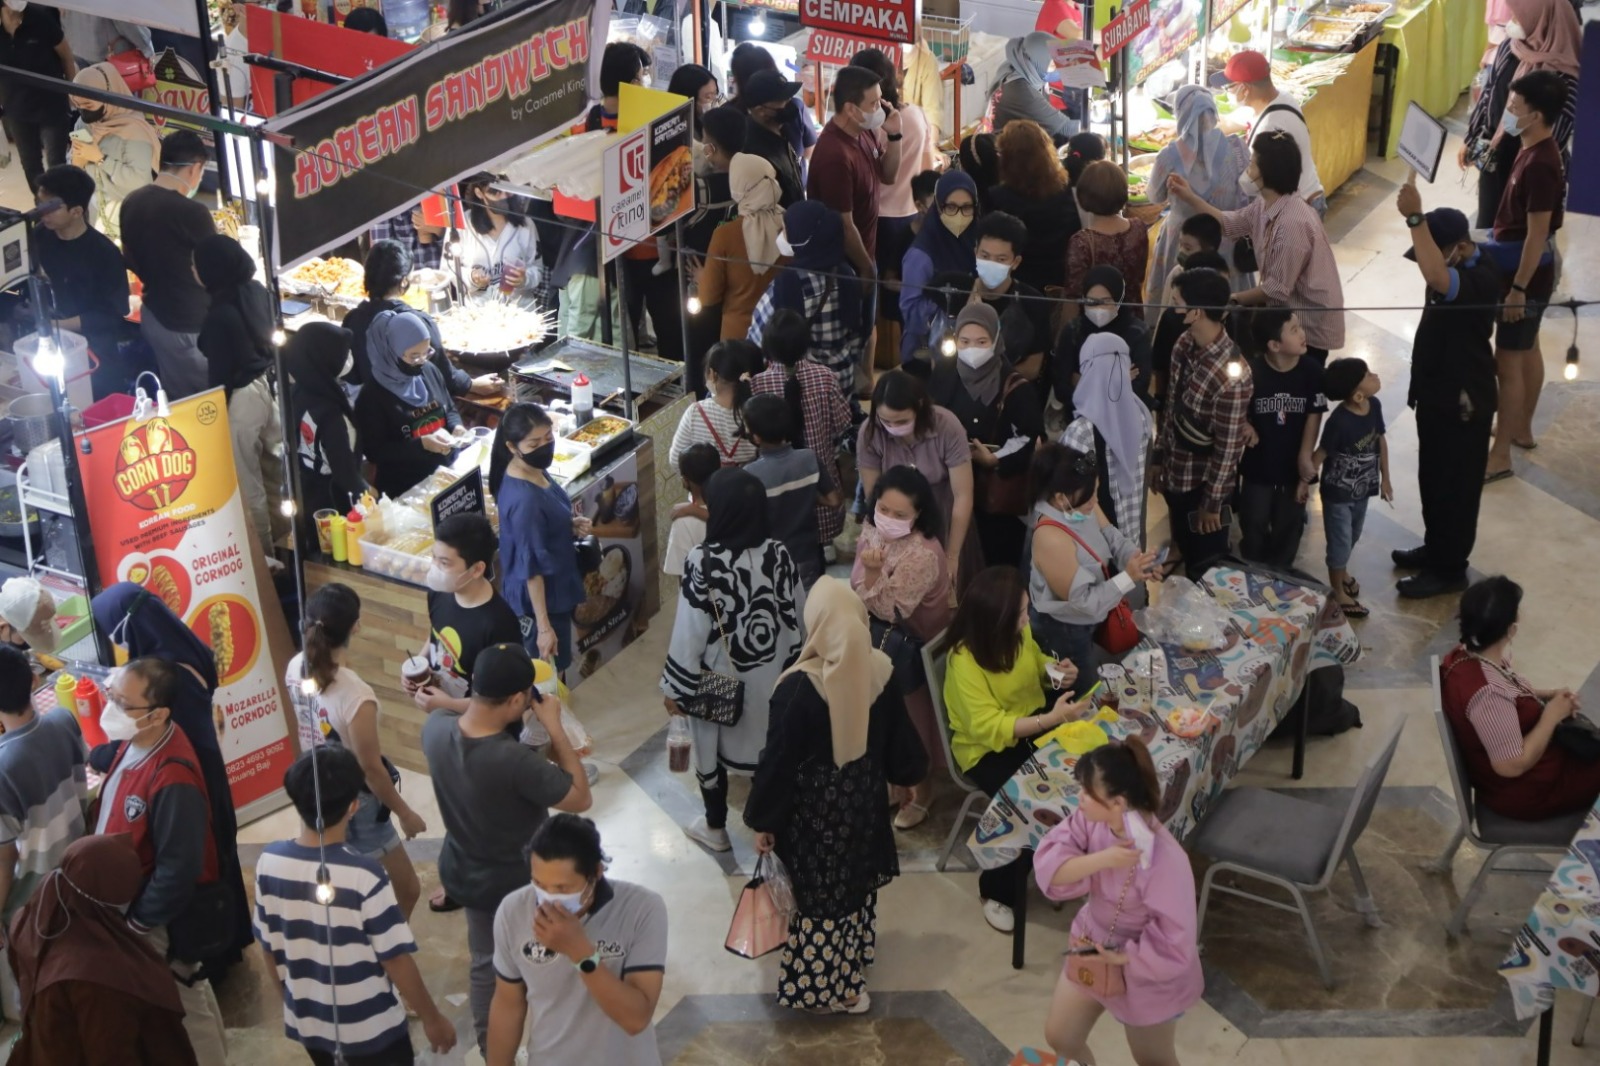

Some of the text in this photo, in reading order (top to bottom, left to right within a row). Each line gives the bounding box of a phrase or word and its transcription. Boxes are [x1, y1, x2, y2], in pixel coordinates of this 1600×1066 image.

[805, 0, 909, 34] CEMPAKA
[1104, 9, 1150, 53] SURABAYA
[292, 16, 590, 199] KOREAN SANDWICH
[511, 78, 586, 121] by Caramel King
[117, 452, 193, 495] CORN DOG
[120, 507, 215, 546] USED PREMIUM INGREDIENTS
[139, 503, 196, 529] KOREAN FOOD
[134, 519, 206, 550] WITH BEEF SAUSAGES
[192, 543, 240, 571] ORIGINAL
[194, 558, 243, 586] CORNDOG
[582, 609, 627, 647] Wagyu Steak
[225, 687, 277, 716] MOZARELLA
[231, 701, 278, 729] CORNDOG
[265, 742, 285, 755] 9092
